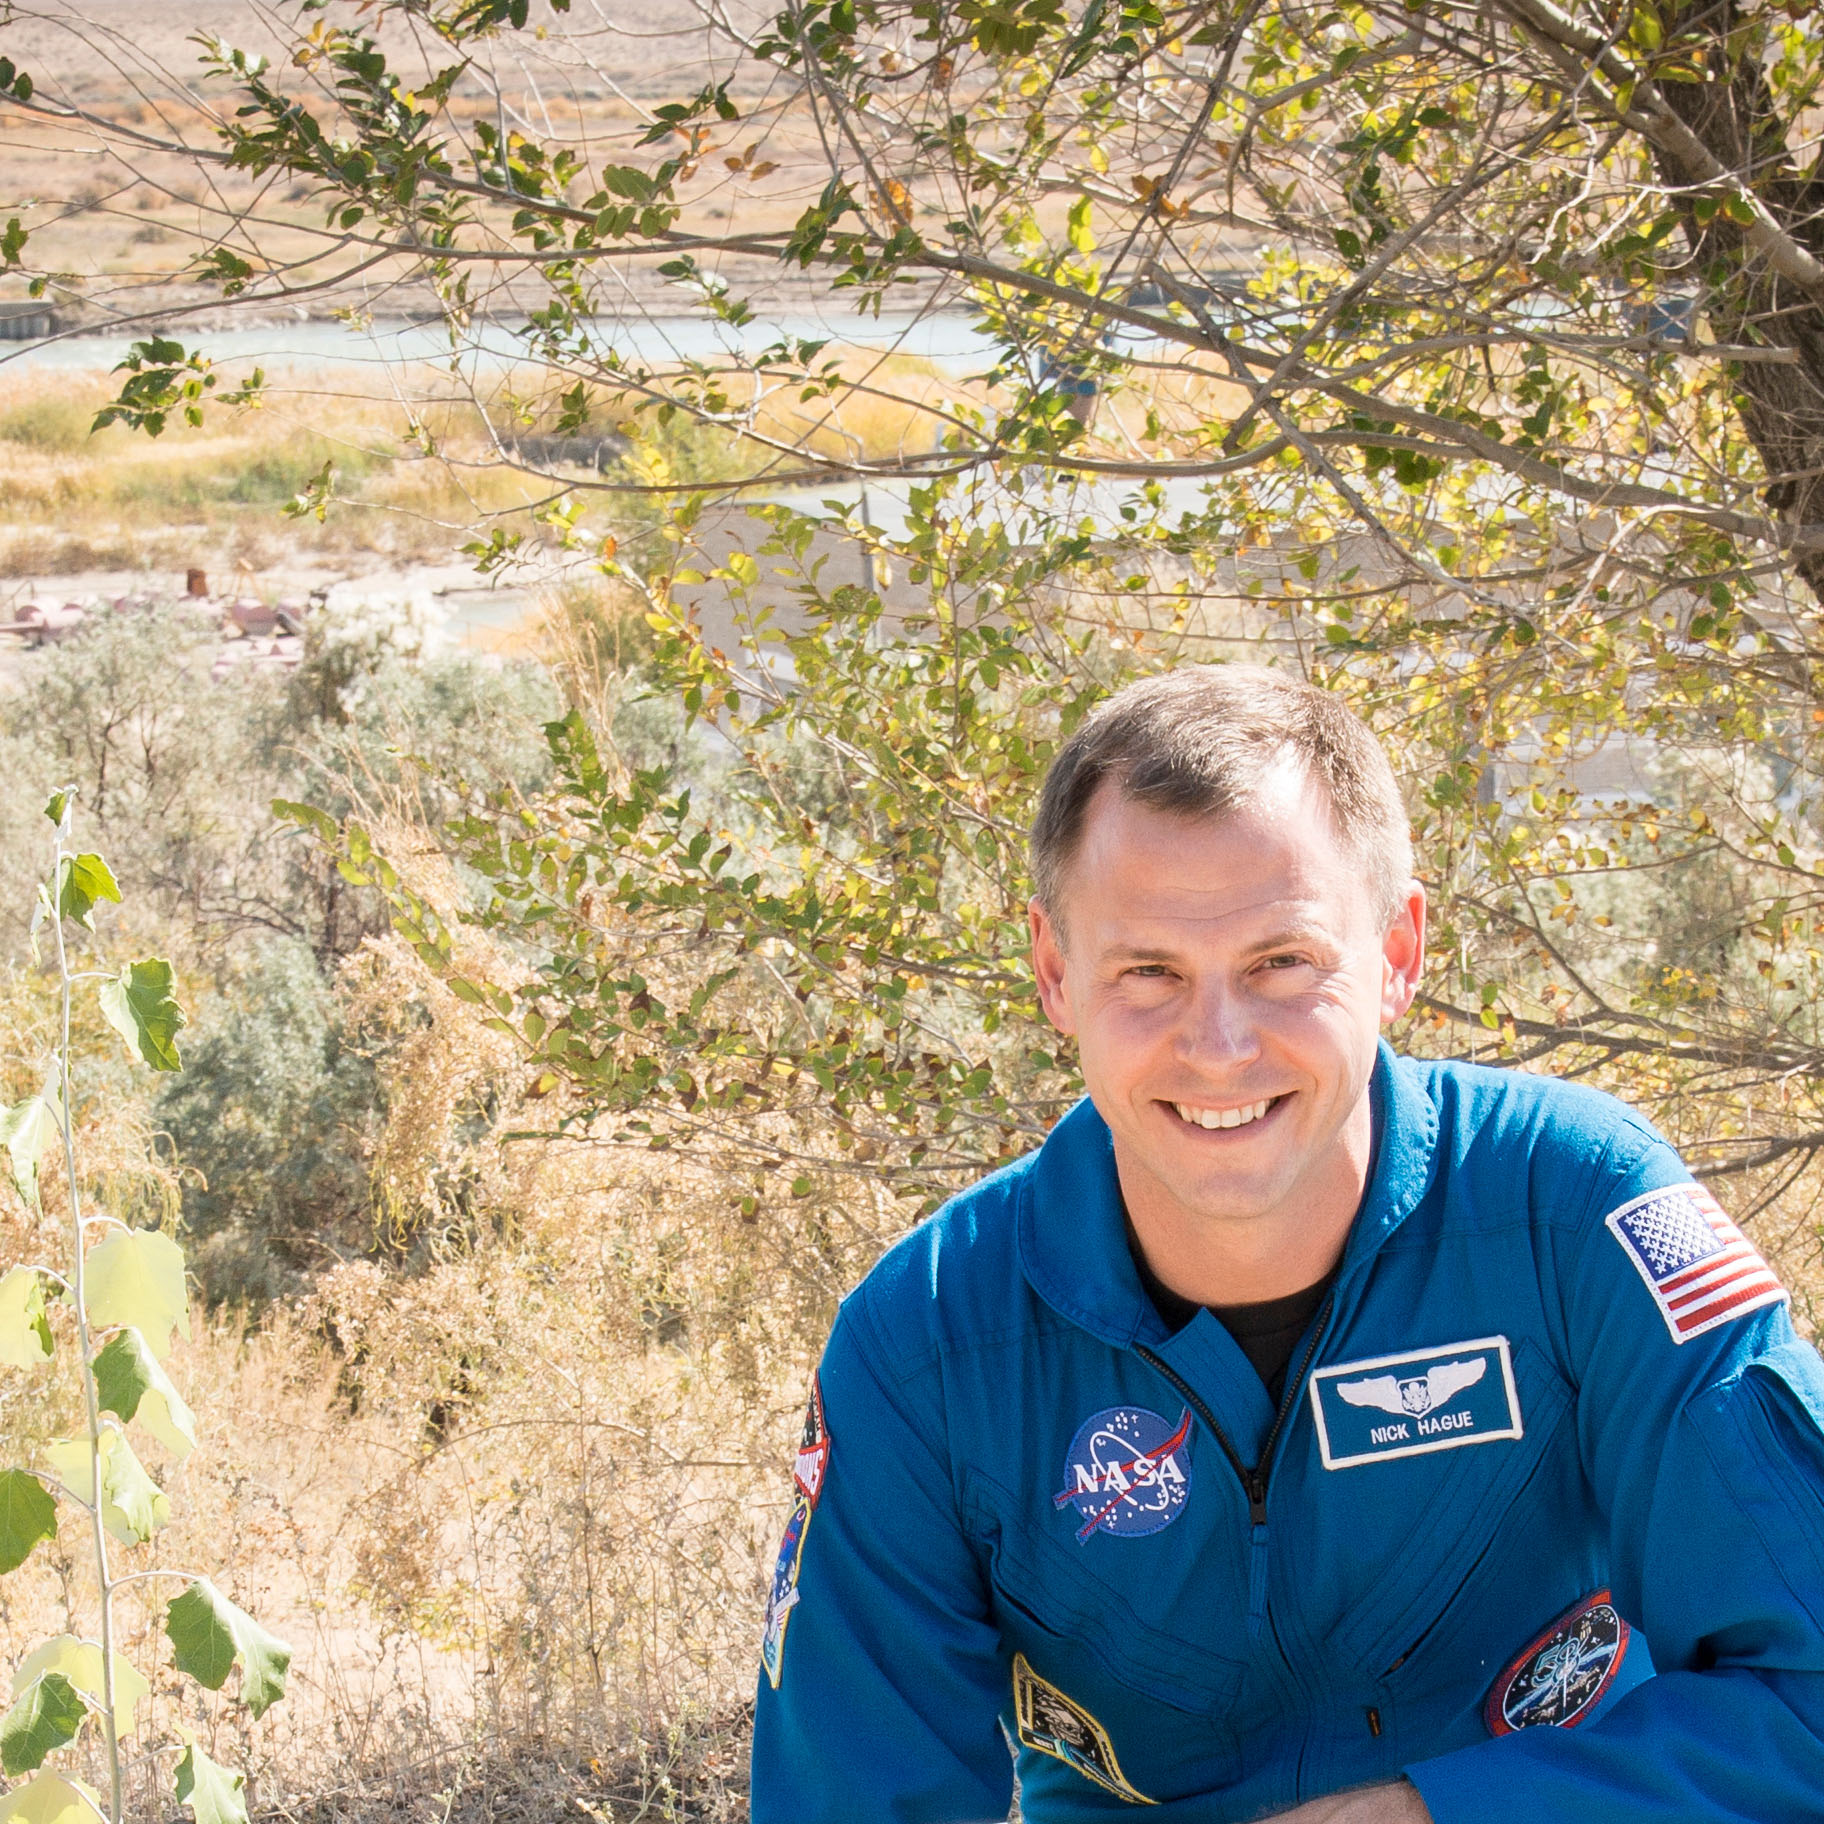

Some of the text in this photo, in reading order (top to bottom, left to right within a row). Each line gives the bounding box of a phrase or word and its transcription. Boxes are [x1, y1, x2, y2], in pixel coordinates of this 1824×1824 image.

[1371, 1410, 1474, 1445] NICK HAGUE
[1072, 1453, 1186, 1494] NASA
